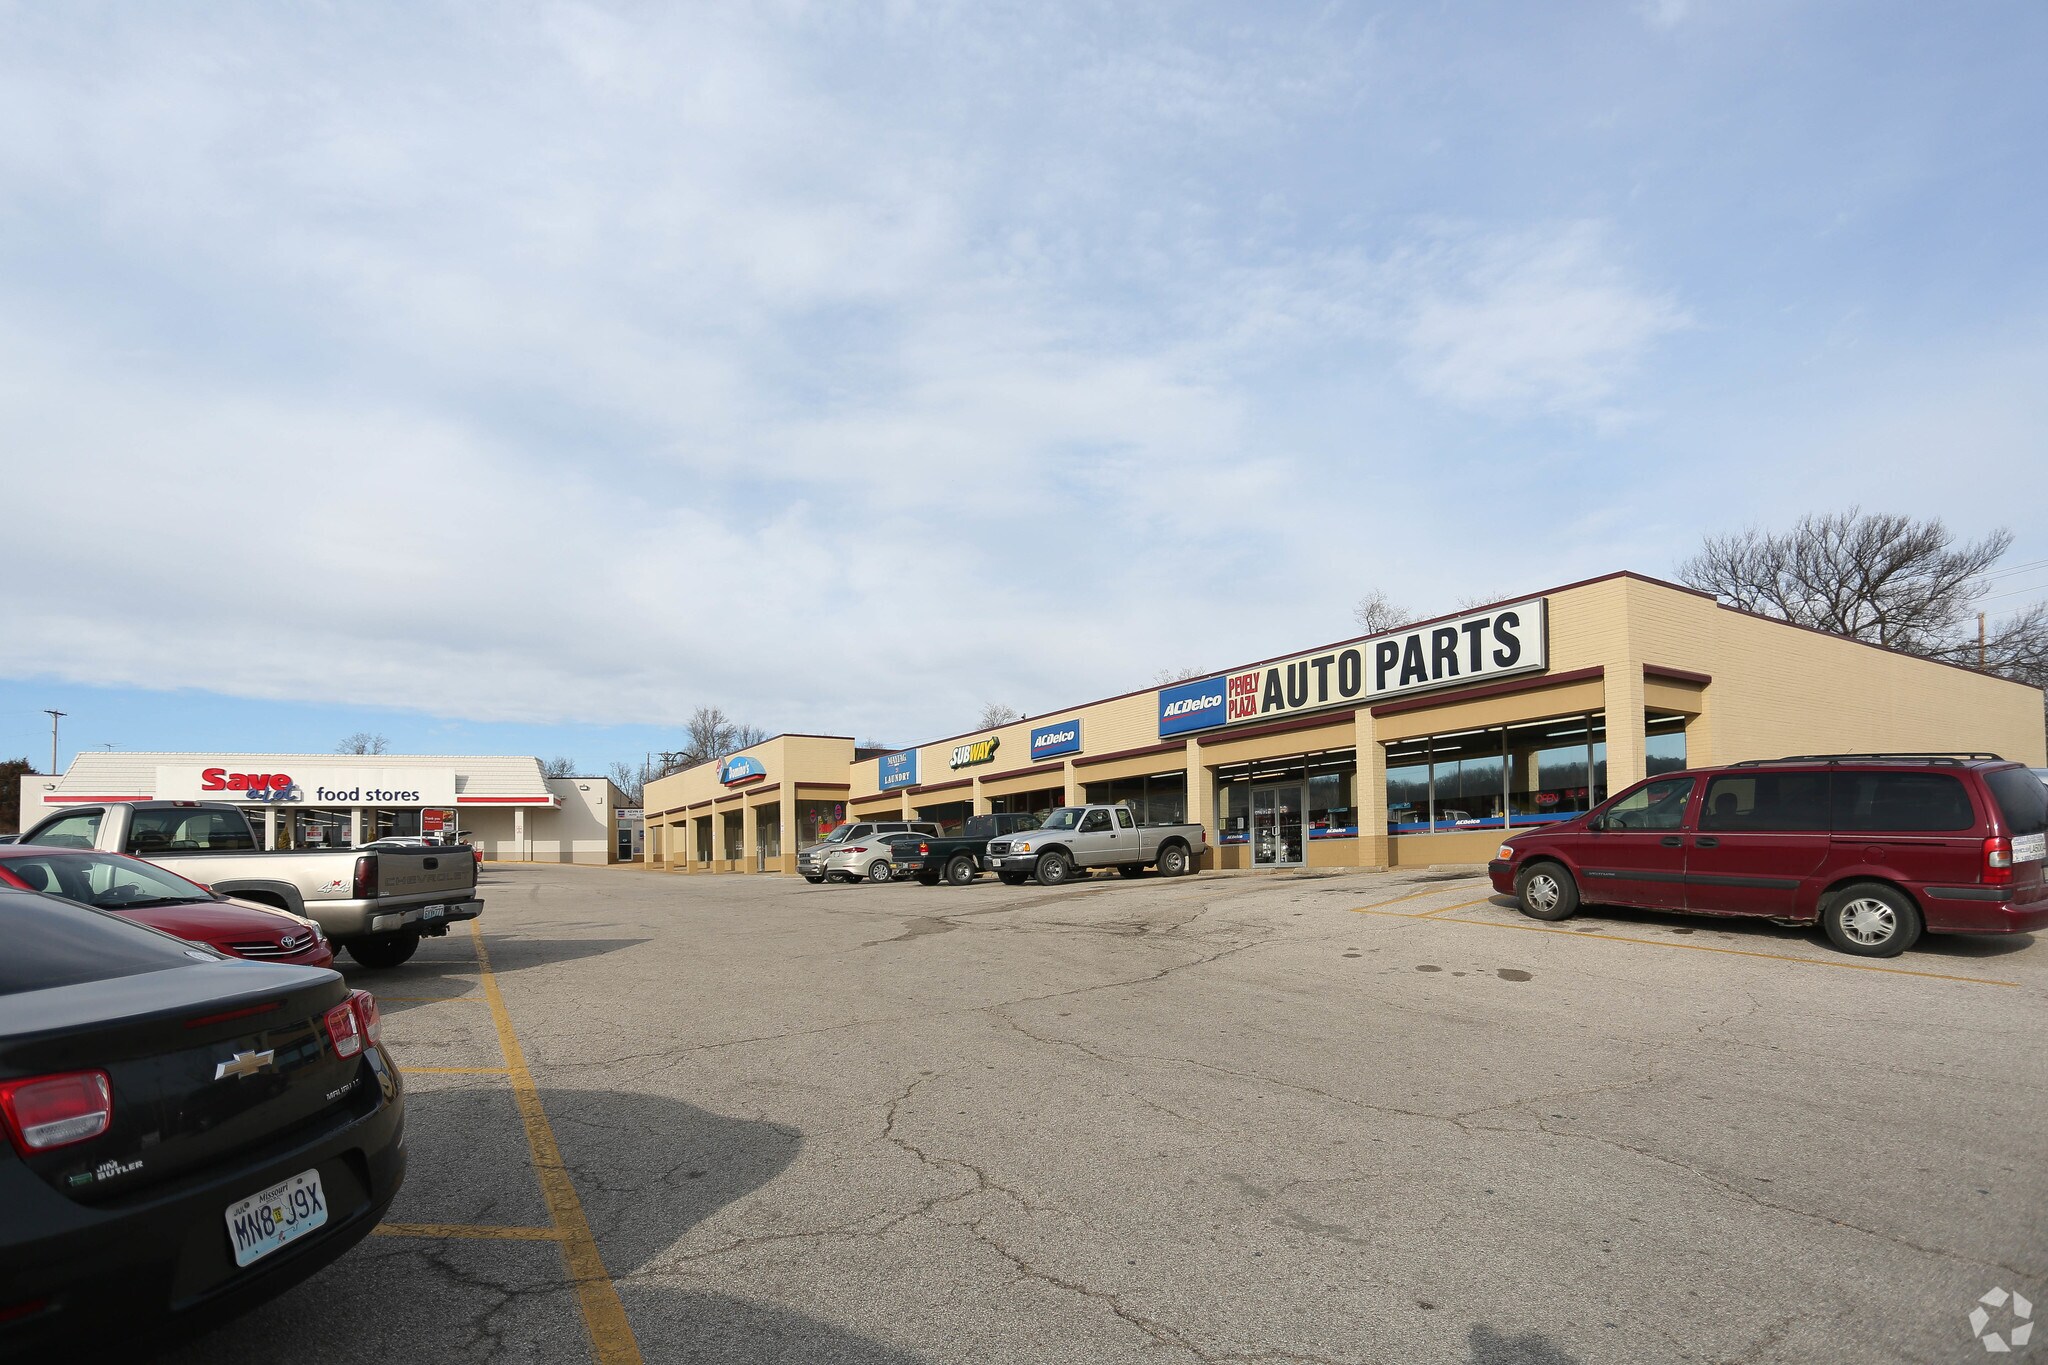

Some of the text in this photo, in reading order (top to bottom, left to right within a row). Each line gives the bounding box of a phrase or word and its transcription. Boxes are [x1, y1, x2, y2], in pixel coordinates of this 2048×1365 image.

[1261, 611, 1521, 714] AUTO PARTS
[1229, 672, 1260, 699] PEVELY
[1163, 694, 1222, 717] ACDelco
[1229, 695, 1258, 720] PLAZA
[1034, 730, 1075, 748] ACDelco
[950, 739, 995, 767] SUBWAY
[201, 768, 292, 791] Save
[884, 772, 910, 784] LAUNDRY
[316, 787, 420, 801] food stores
[1535, 793, 1559, 804] OPEN
[384, 870, 470, 887] CHEVROLET
[97, 1160, 118, 1173] JIM
[97, 1160, 144, 1181] BUTLER
[259, 1182, 289, 1203] Missouri
[233, 1182, 323, 1251] MN8 J9X
